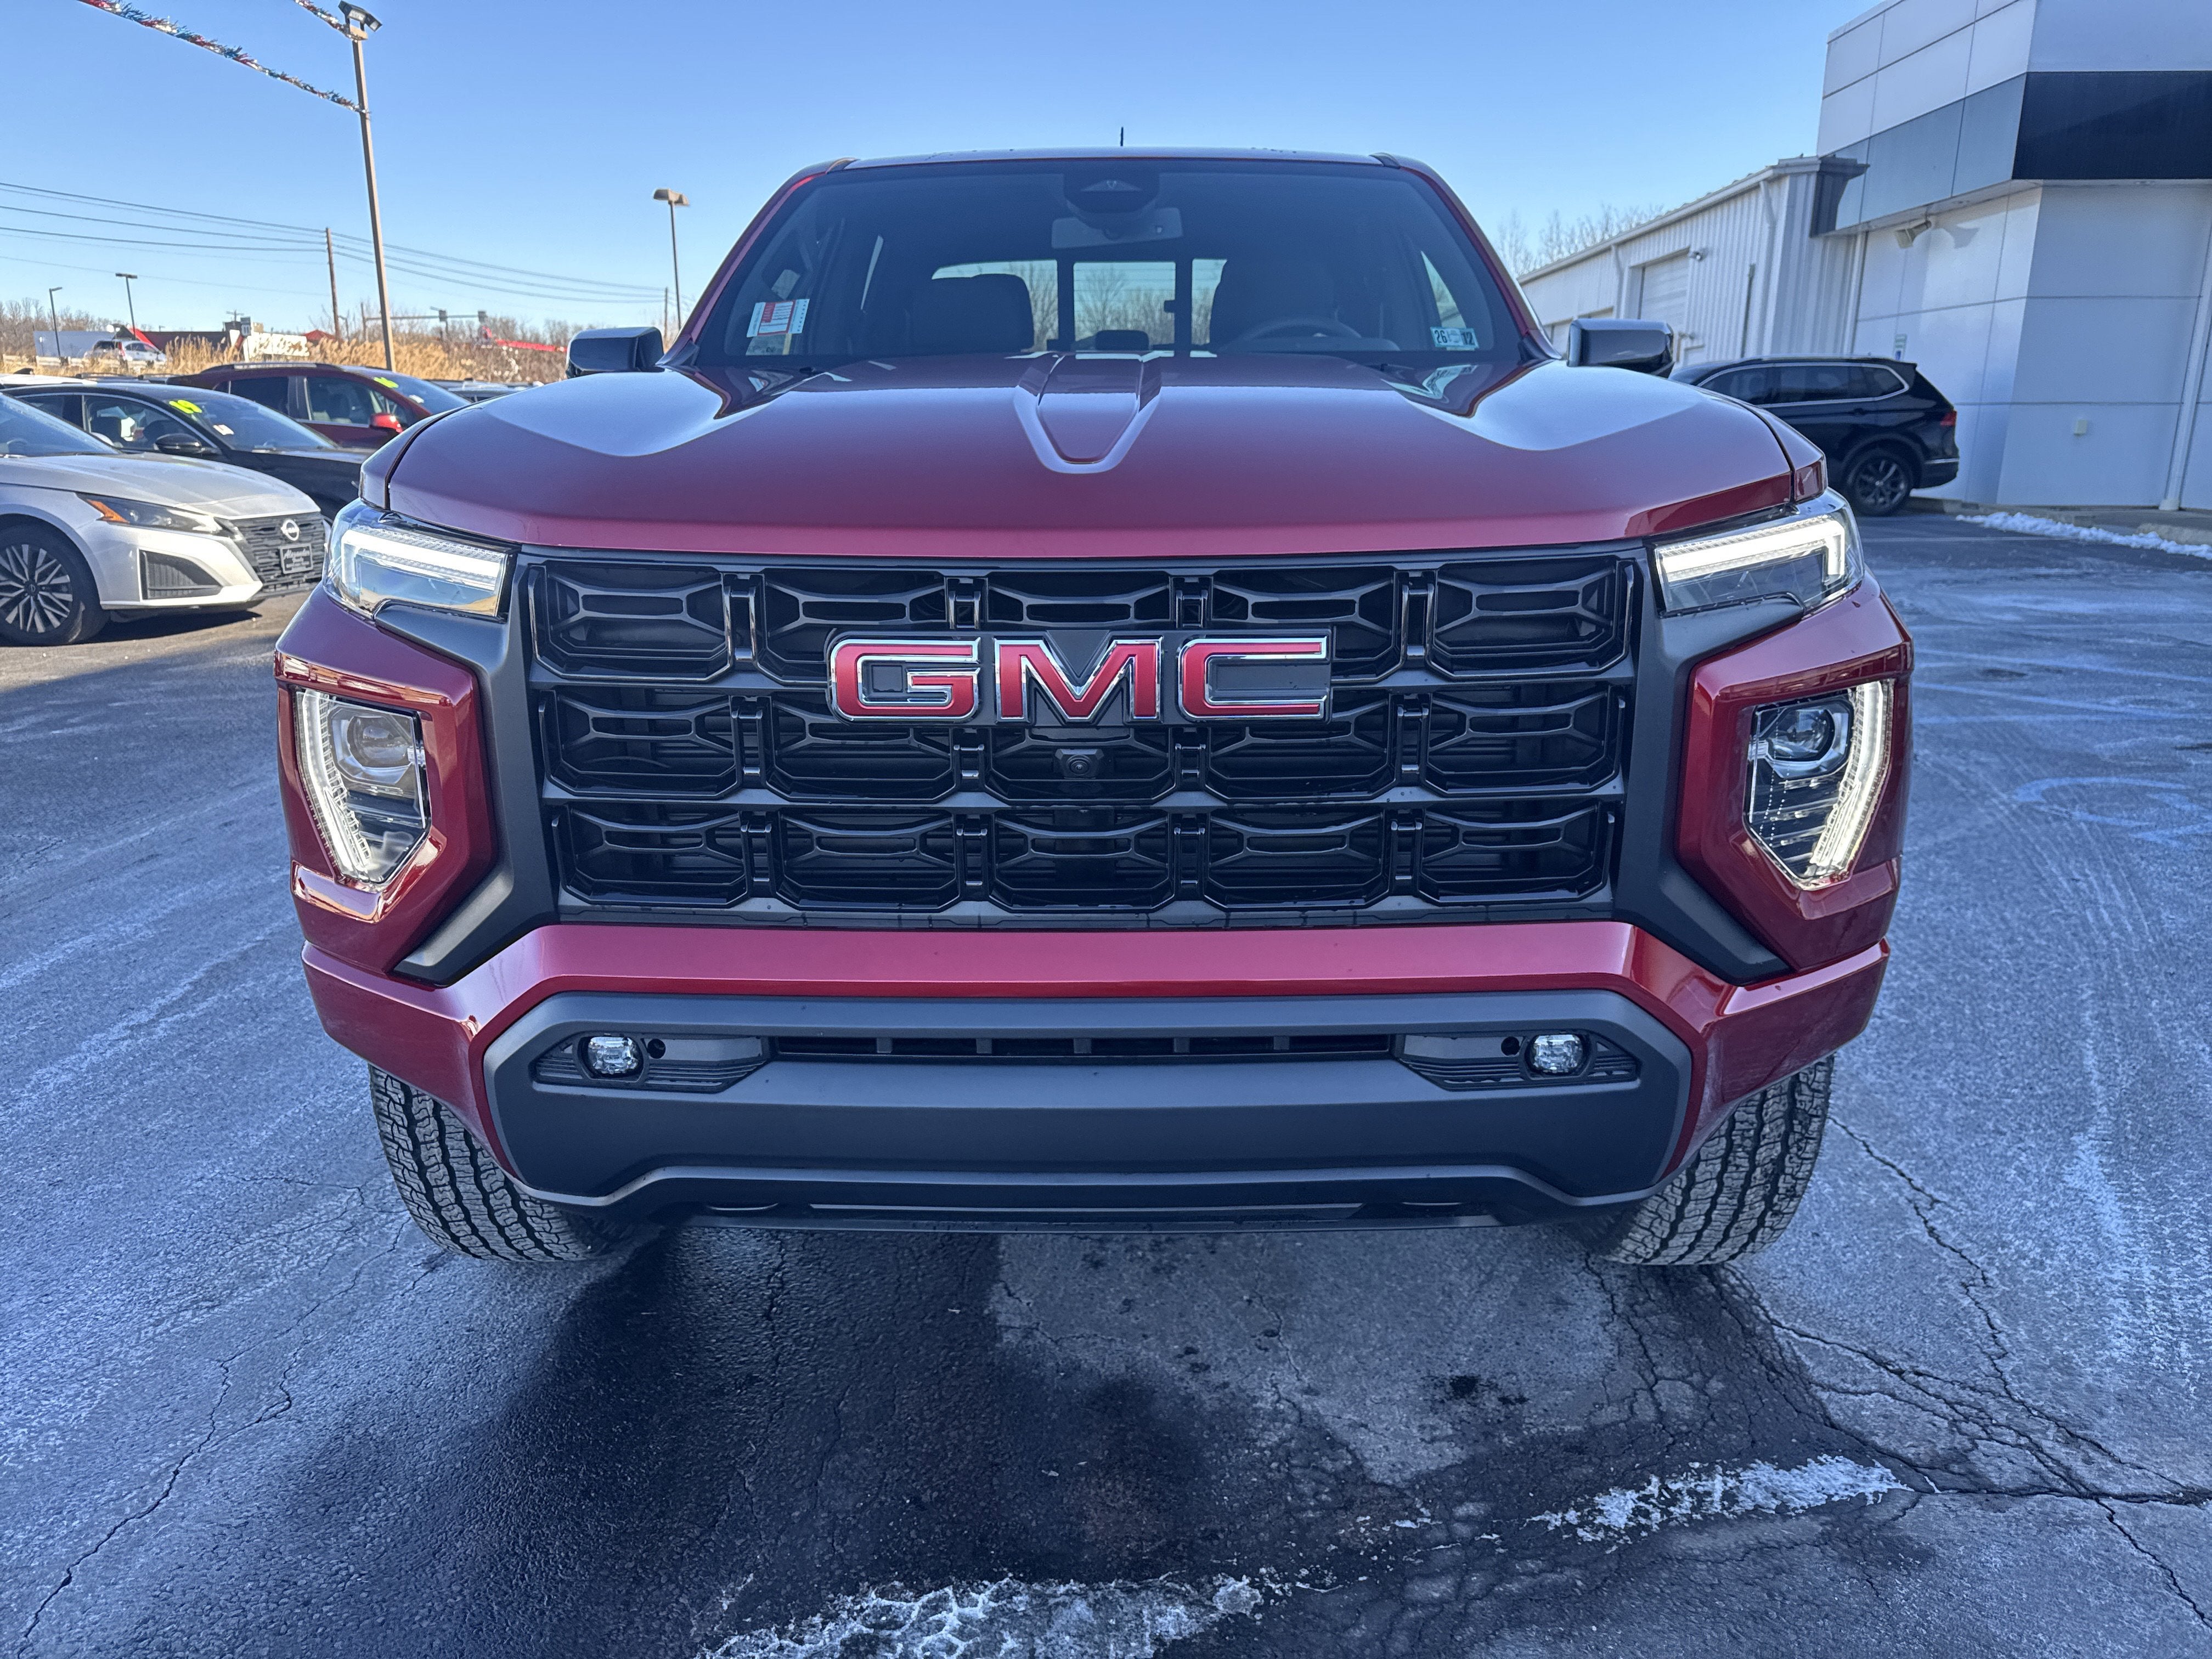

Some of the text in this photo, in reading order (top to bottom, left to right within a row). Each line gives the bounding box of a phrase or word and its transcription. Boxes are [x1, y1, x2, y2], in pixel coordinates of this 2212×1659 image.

[1434, 330, 1476, 346] 26 12
[831, 636, 1328, 723] GMC
